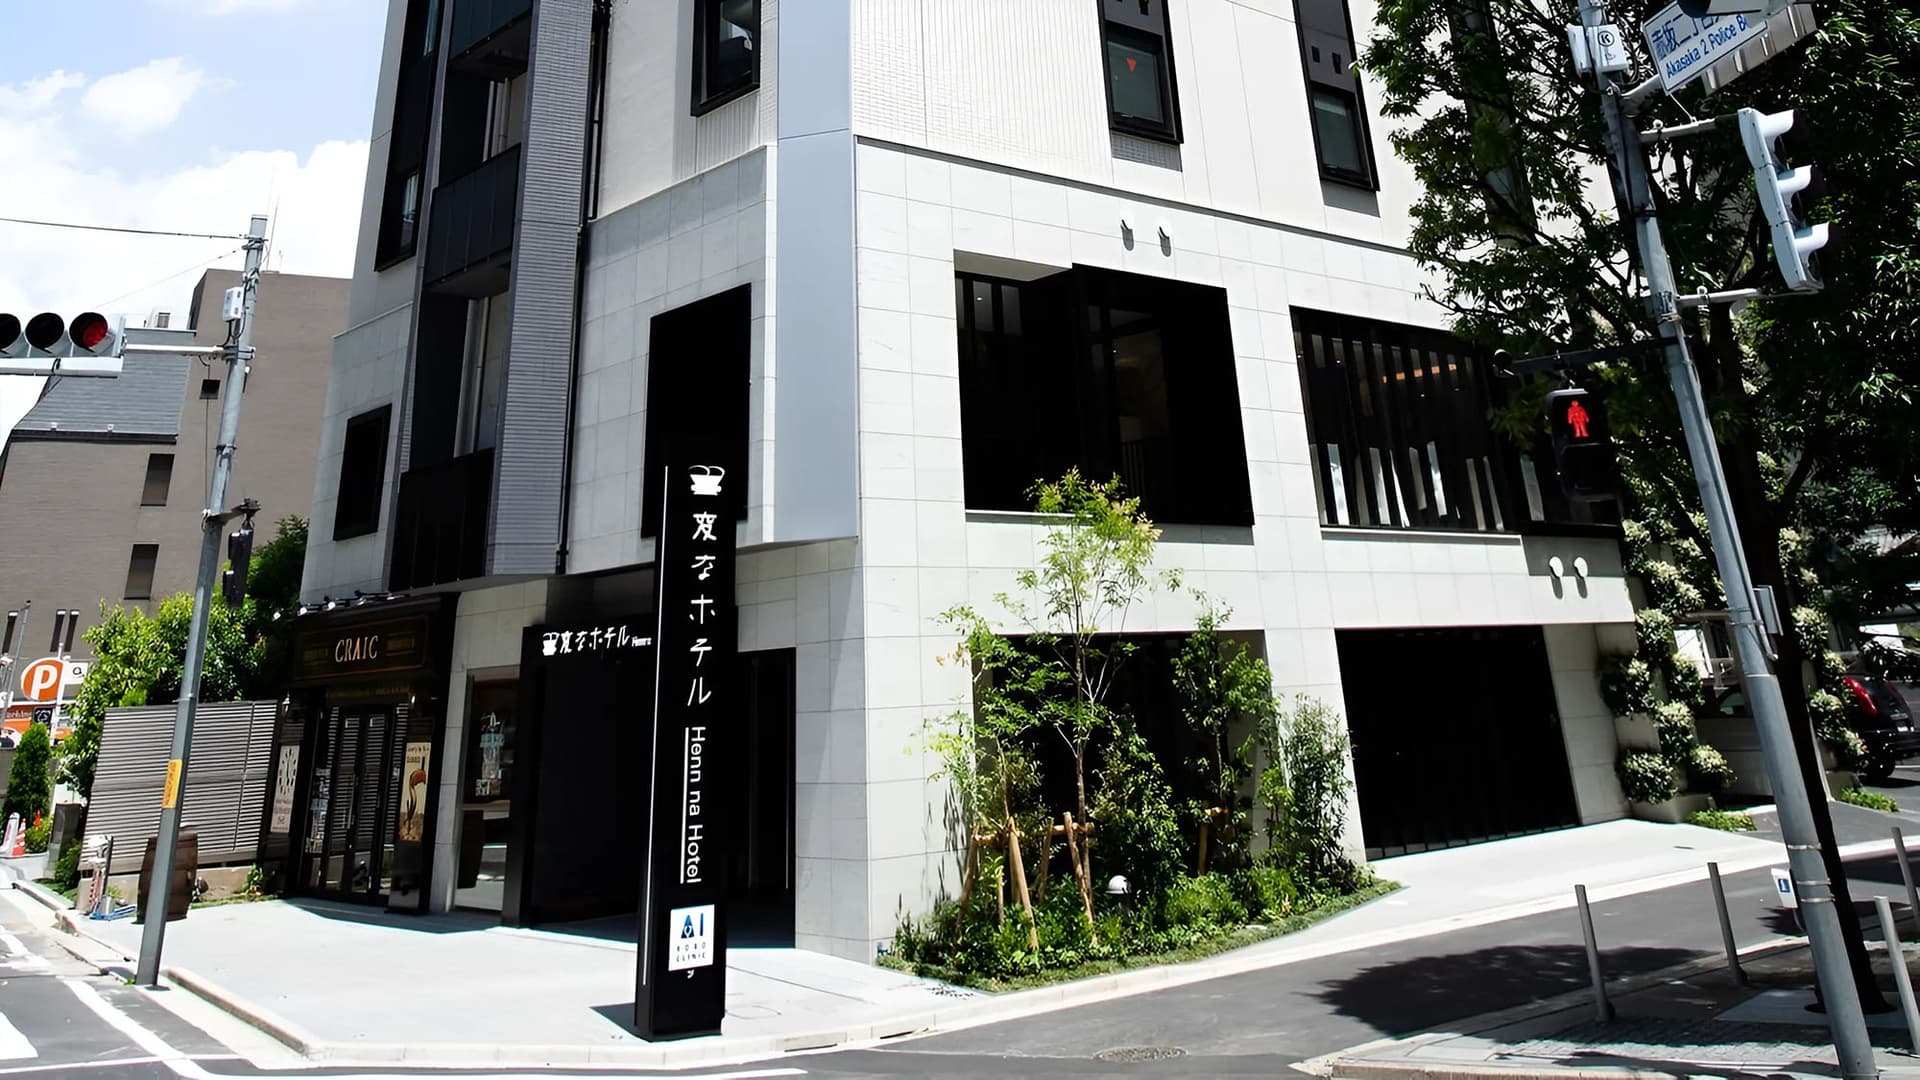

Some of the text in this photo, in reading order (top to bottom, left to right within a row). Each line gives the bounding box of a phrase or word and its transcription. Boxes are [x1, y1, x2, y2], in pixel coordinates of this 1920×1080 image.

[1666, 47, 1701, 79] Akasaka
[1700, 38, 1710, 56] 2
[1708, 24, 1737, 51] Police
[687, 510, 718, 707] 変なホテル
[335, 635, 378, 663] CRAIC
[559, 625, 631, 654] 変なホテル
[30, 664, 58, 701] P
[686, 726, 707, 884] Henn na Hotel
[681, 912, 704, 939] AI
